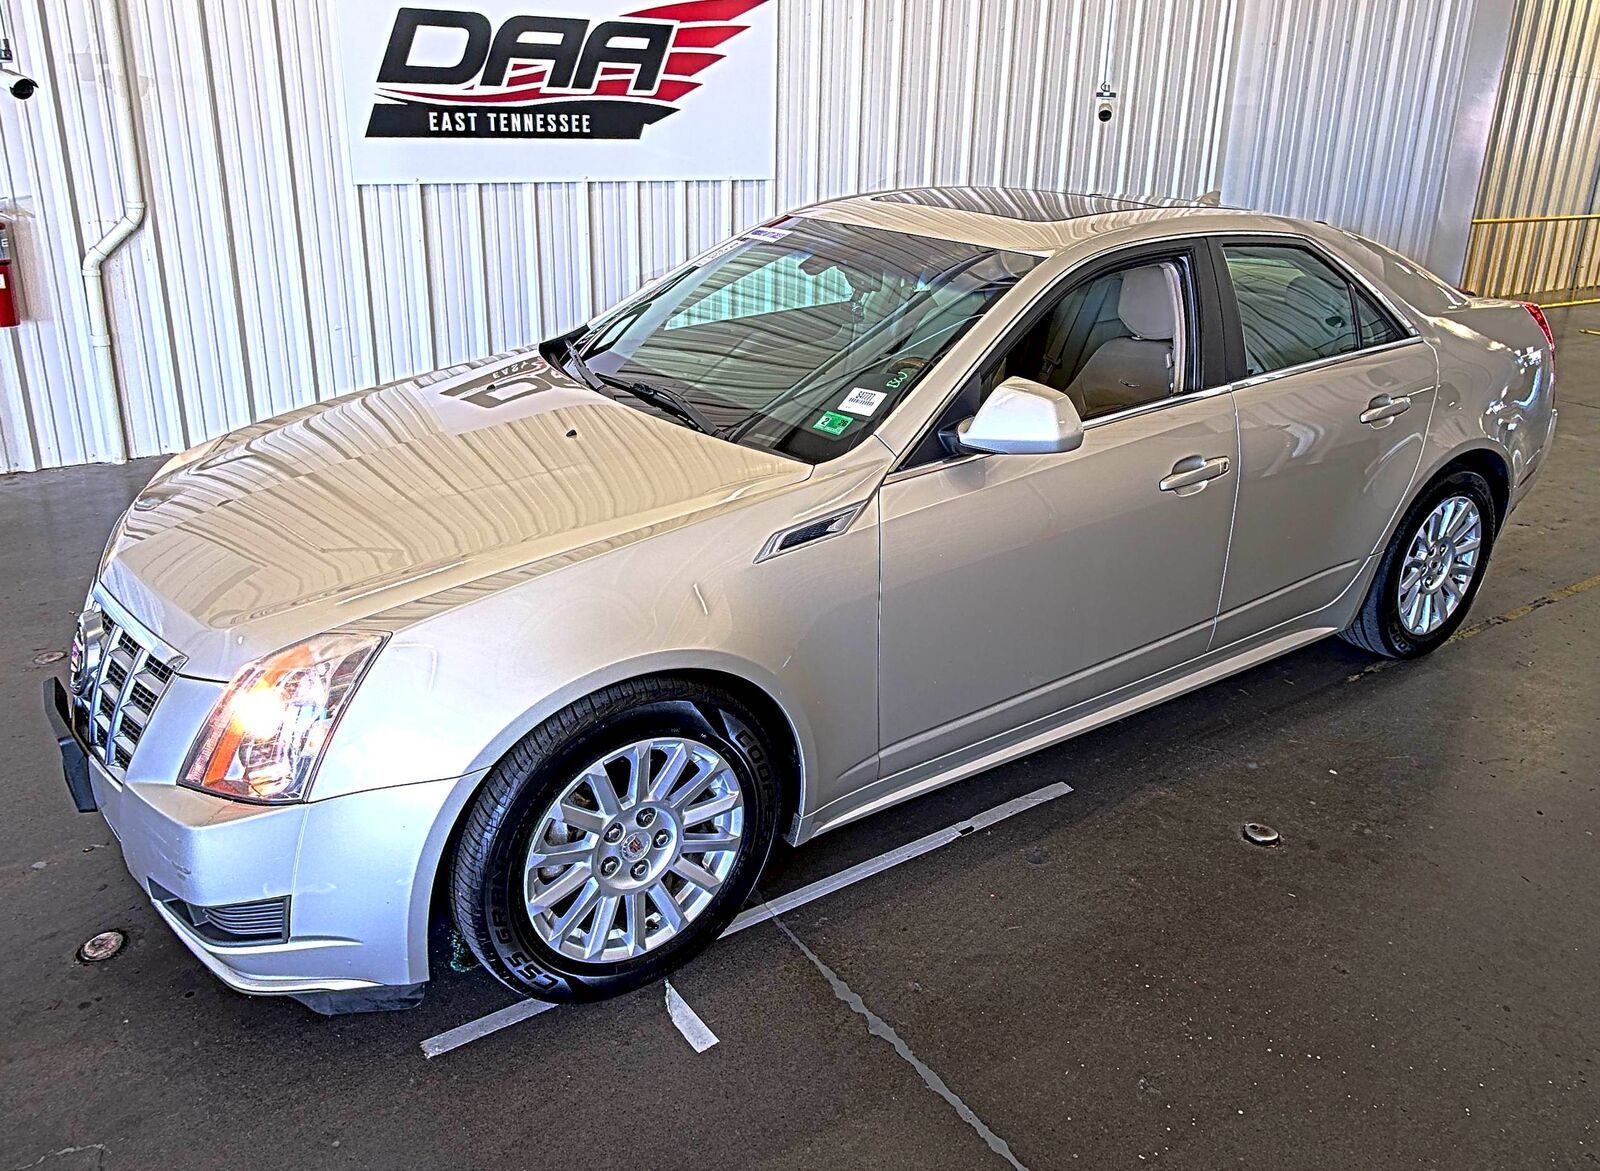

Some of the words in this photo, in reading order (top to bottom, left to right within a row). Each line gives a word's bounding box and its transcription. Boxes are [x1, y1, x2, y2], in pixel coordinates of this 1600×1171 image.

[376, 7, 675, 91] DAA
[428, 111, 478, 132] EAST
[487, 112, 591, 134] TENNESSEE
[820, 417, 830, 426] 2
